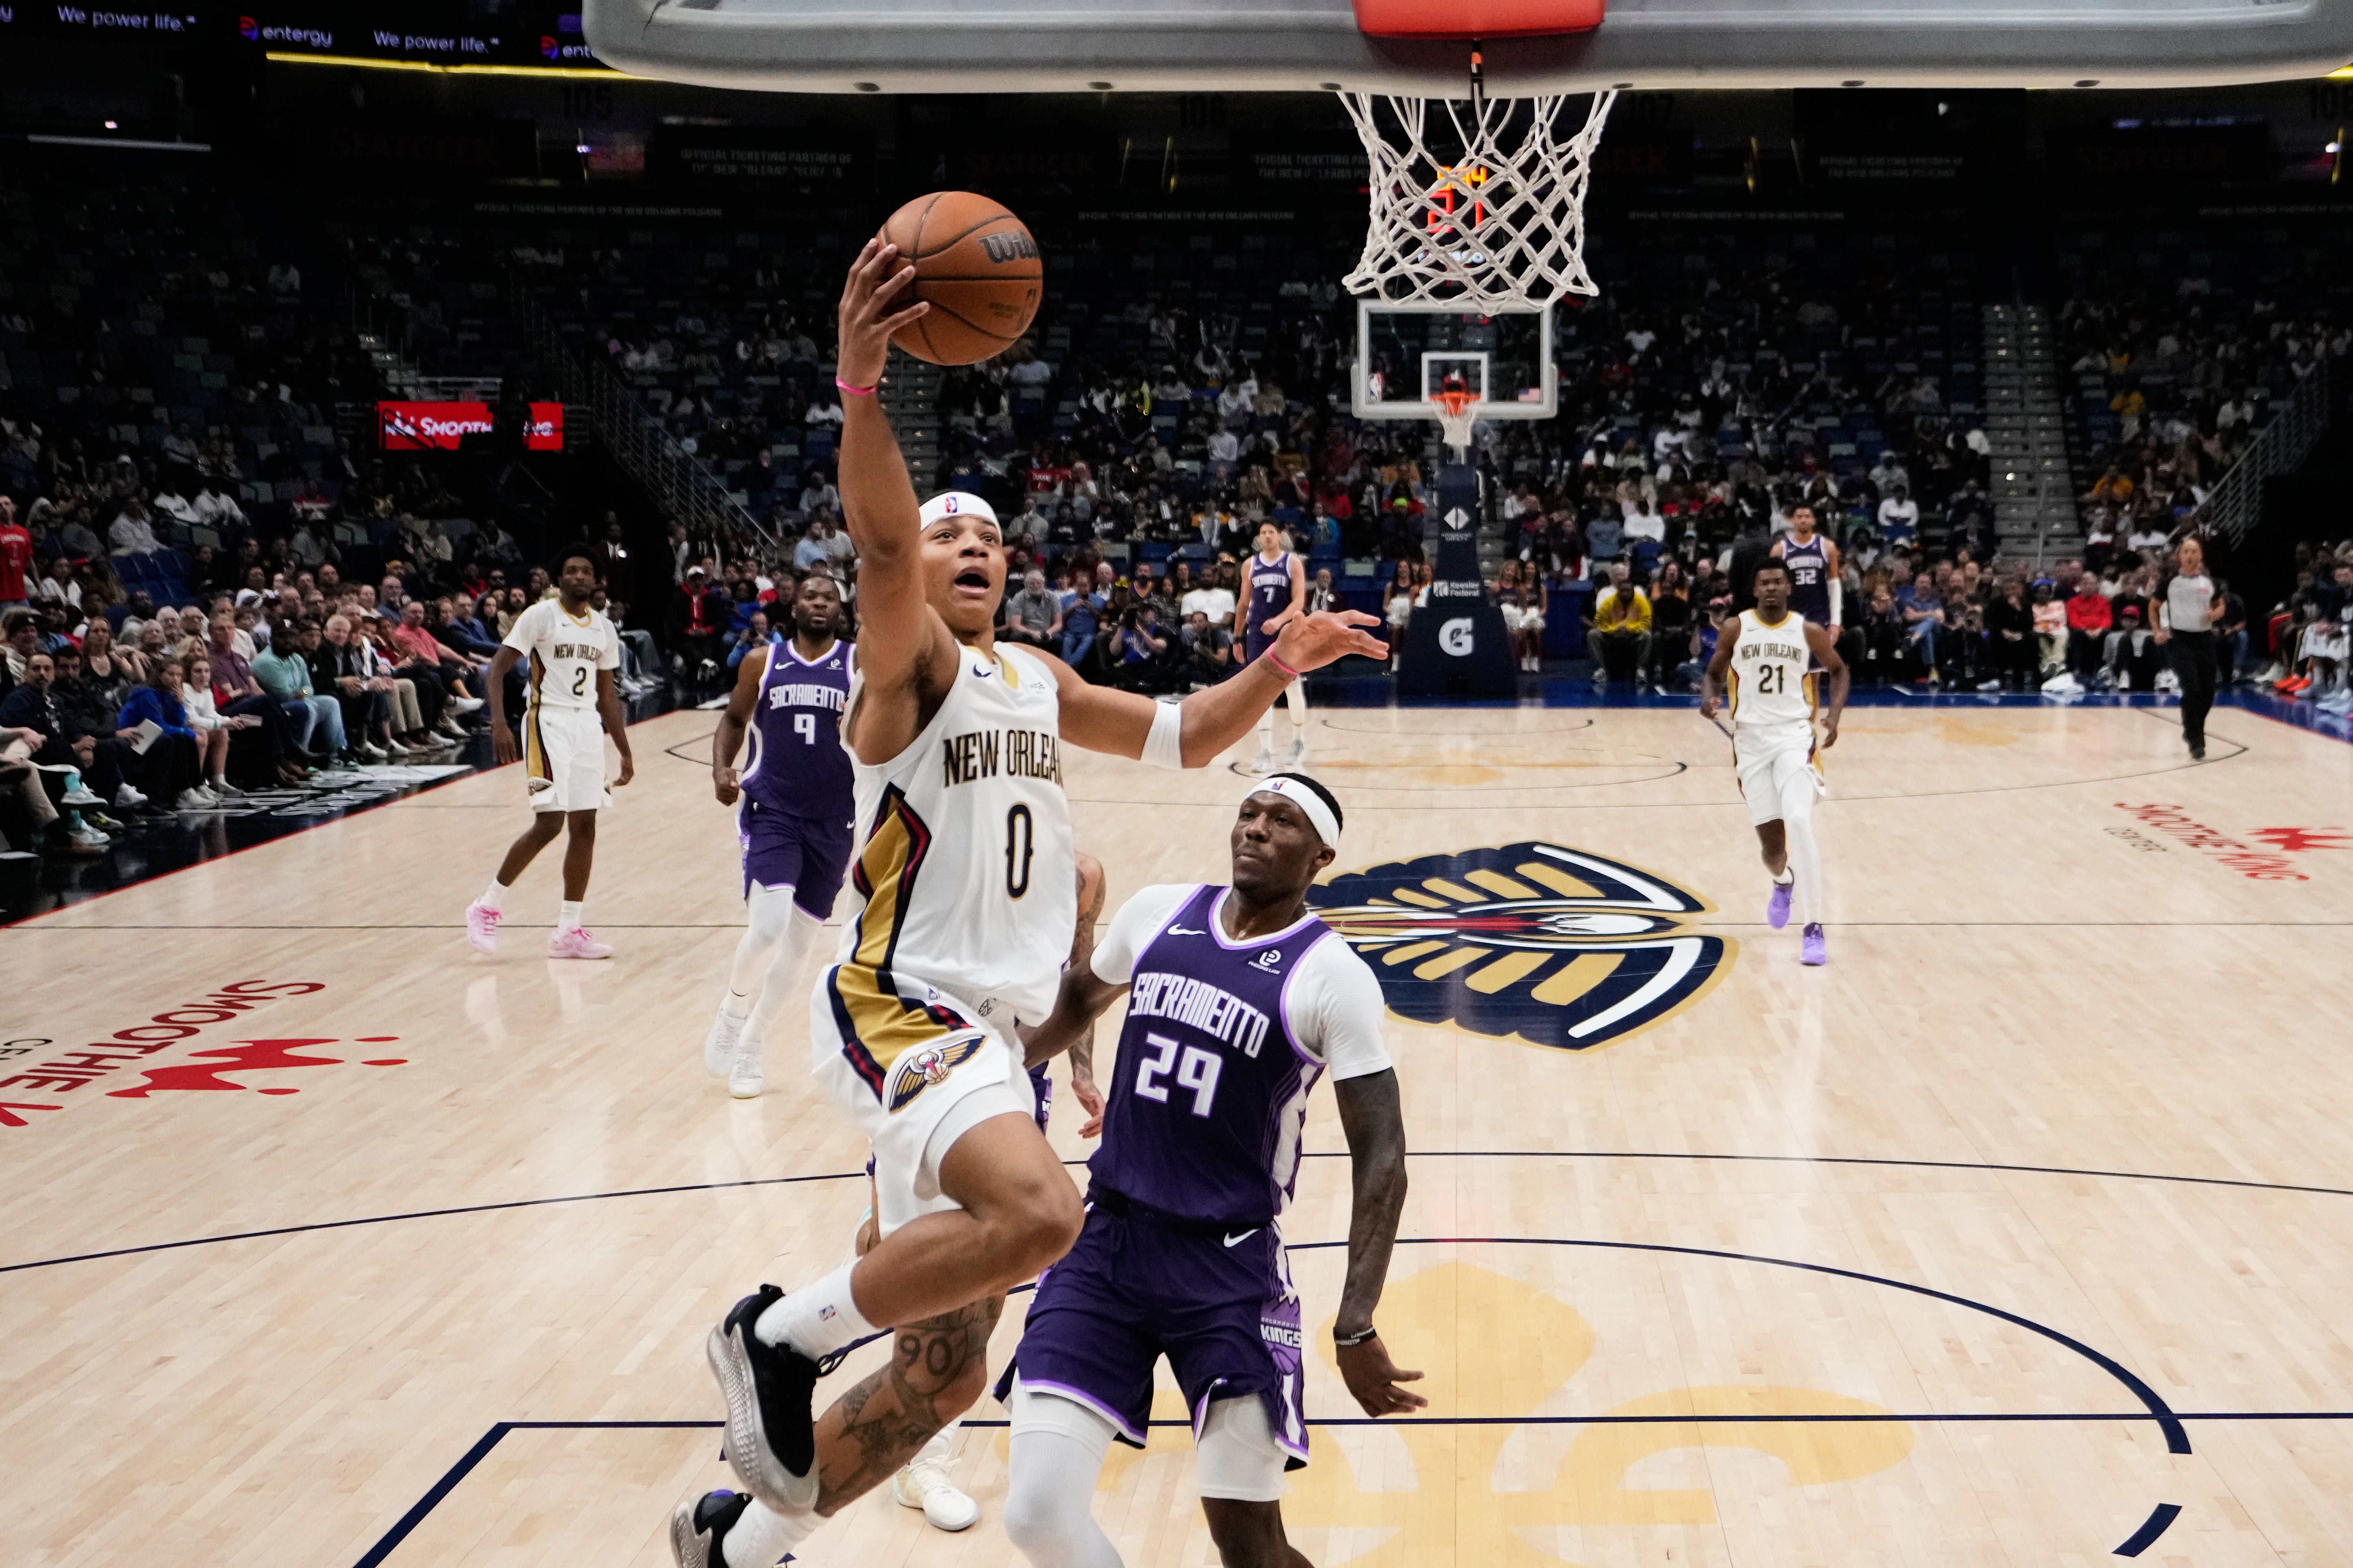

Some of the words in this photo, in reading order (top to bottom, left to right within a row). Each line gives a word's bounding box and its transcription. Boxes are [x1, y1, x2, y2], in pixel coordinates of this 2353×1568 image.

[57, 4, 87, 24] We
[93, 11, 149, 29] power
[262, 24, 334, 48] entergy
[373, 29, 401, 48] We
[405, 35, 455, 52] power
[1794, 569, 1817, 585] 32
[1264, 587, 1275, 603] 7
[1450, 589, 1480, 597] Federal
[554, 643, 575, 659] NEW
[1741, 643, 1761, 661] NEW
[1764, 643, 1802, 663] ORLEANS
[573, 667, 587, 697] 2
[1759, 663, 1785, 695] 21
[769, 684, 846, 713] SACRAMENTO
[794, 713, 815, 745] 9
[943, 730, 999, 788] NEW
[1005, 801, 1034, 902] 0
[2113, 803, 2249, 850] SMOOTHIE
[2202, 852, 2310, 881] KING
[1129, 972, 1270, 1059] SACRAMENTO
[0, 980, 326, 1092] SMOOTHIE
[1134, 1031, 1223, 1119] 29
[1260, 1324, 1301, 1349] KINGS
[899, 1334, 953, 1376] 90
